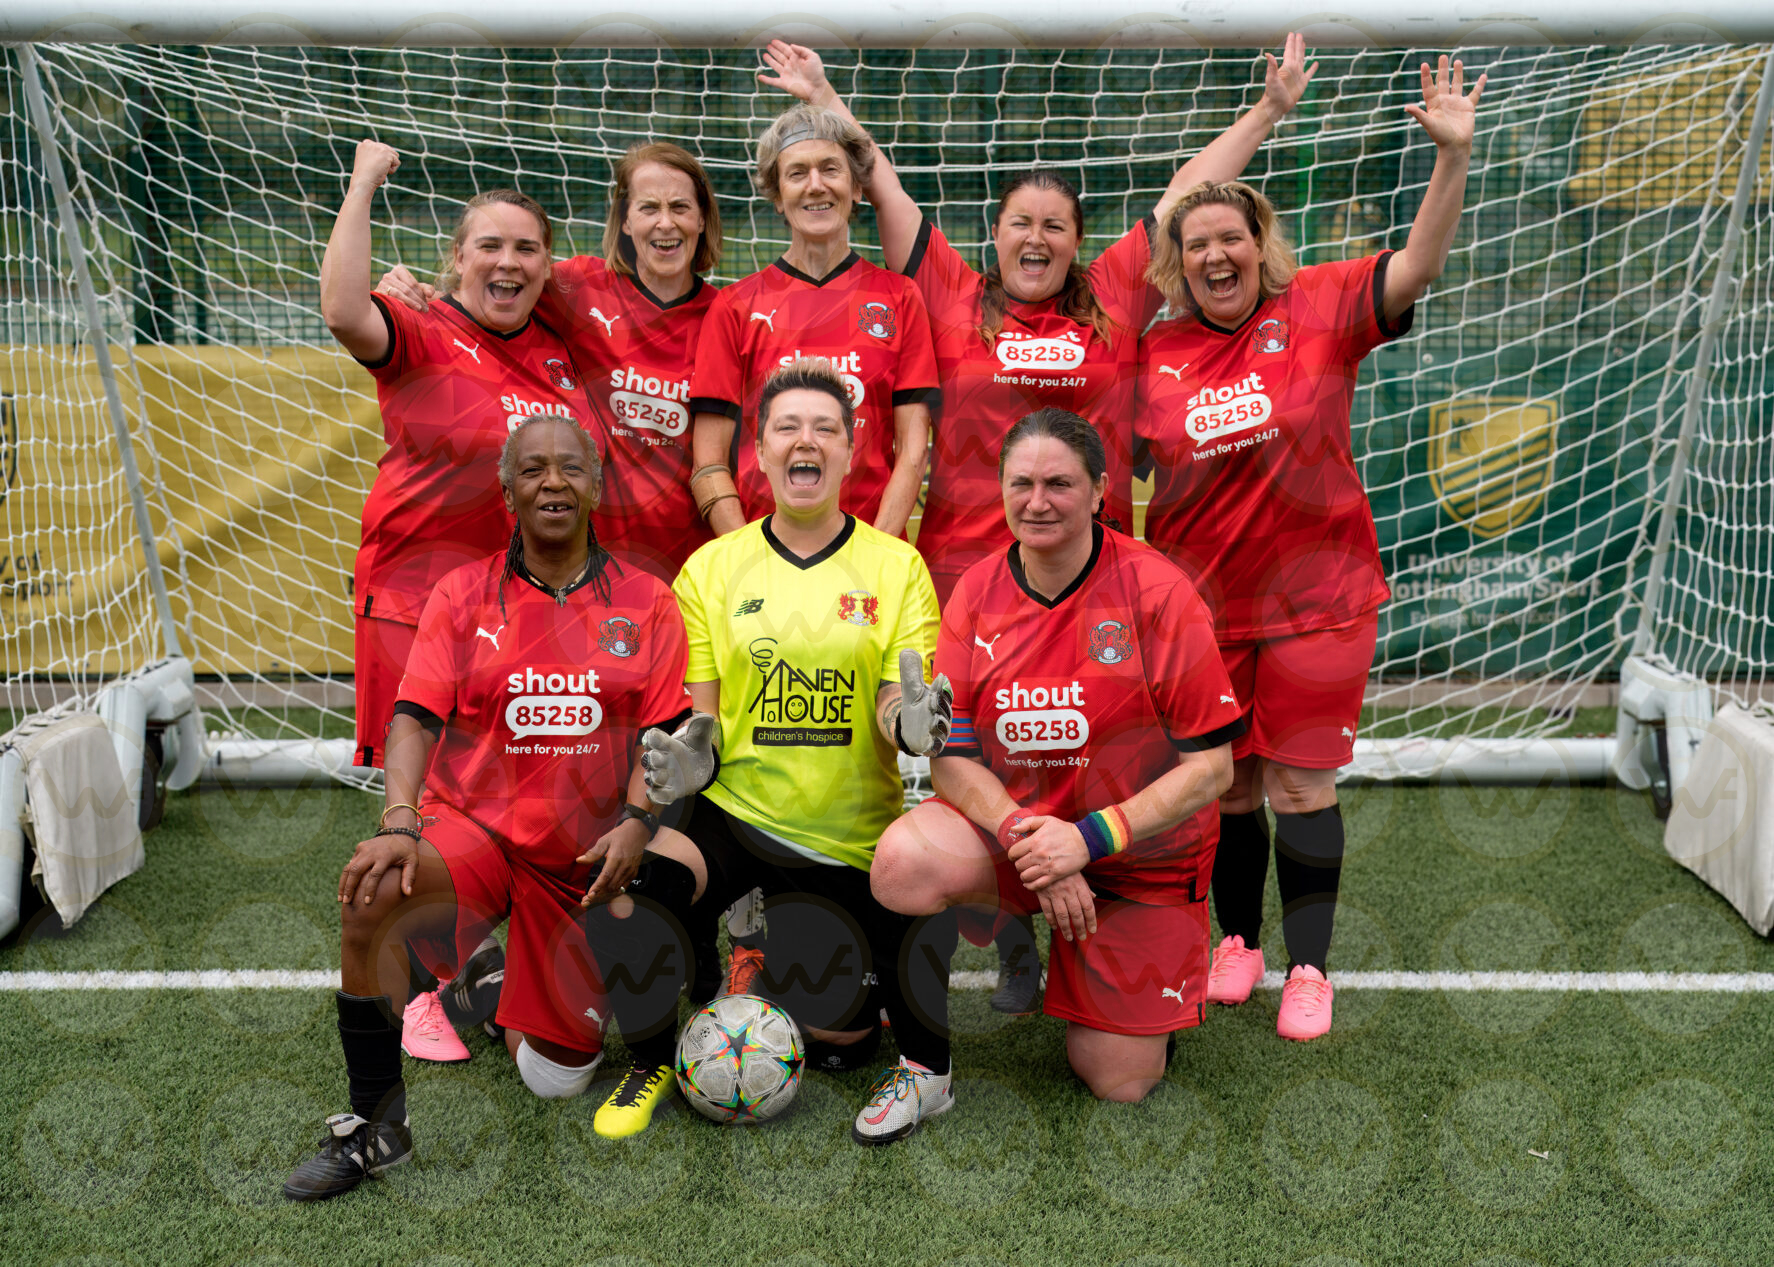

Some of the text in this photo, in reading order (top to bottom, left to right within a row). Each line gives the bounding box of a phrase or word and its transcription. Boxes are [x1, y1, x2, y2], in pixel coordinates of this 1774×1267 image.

[1005, 346, 1077, 362] 85258
[610, 366, 690, 403] shout
[993, 373, 1087, 388] here for you 24/7
[1186, 372, 1265, 411] shout
[616, 399, 681, 430] 85258
[1194, 400, 1264, 433] 85258
[611, 426, 635, 438] here
[1192, 427, 1279, 461] here for you 24/7
[1407, 550, 1572, 578] University of
[1391, 578, 1603, 605] ottingham Sport
[507, 667, 602, 694] shout
[995, 681, 1086, 710] shout
[515, 705, 593, 727] 85258
[757, 731, 844, 743] children's hospice
[1004, 719, 1080, 743] 85258
[505, 743, 600, 757] here for you 24/7
[1004, 756, 1090, 768] here for you 24/7
[862, 972, 879, 986] JO
